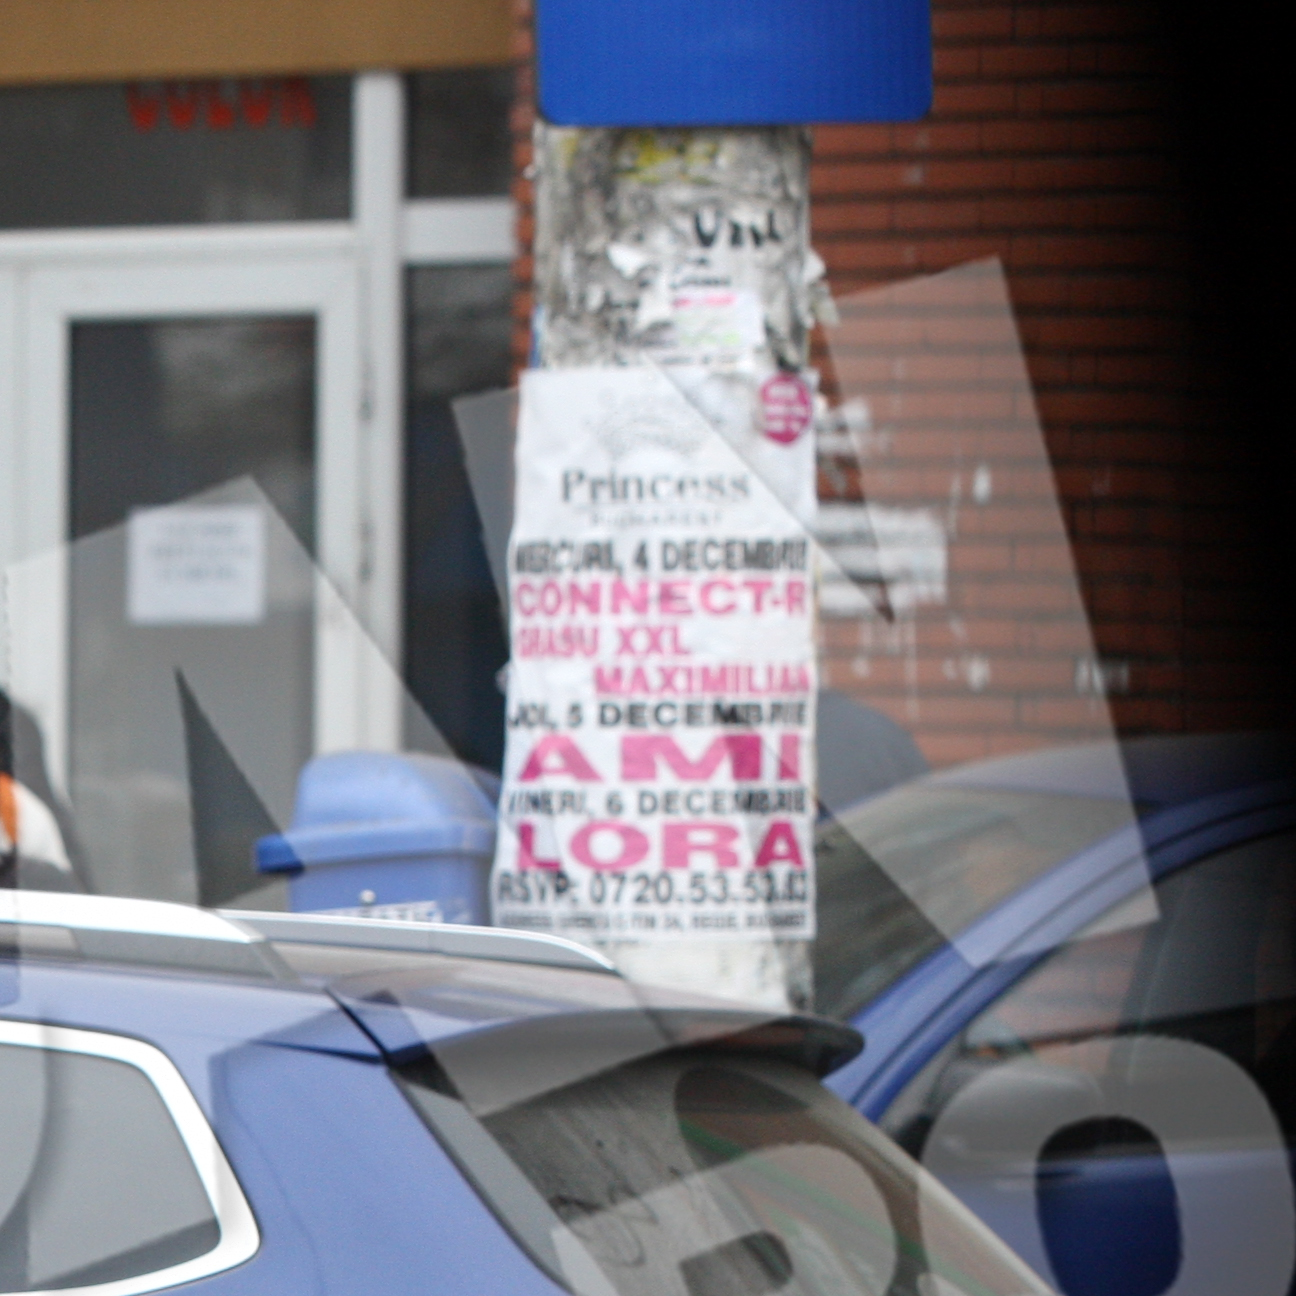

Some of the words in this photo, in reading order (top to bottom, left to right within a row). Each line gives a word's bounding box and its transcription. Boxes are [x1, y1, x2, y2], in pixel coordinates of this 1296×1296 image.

[562, 469, 751, 502] Princess
[631, 540, 649, 572] 4
[515, 578, 807, 617] CONNECT-R
[616, 625, 693, 657] XXL
[566, 702, 585, 728] 5
[598, 701, 807, 728] DECEMBRIE
[517, 733, 802, 783] AMI
[605, 790, 624, 816] 6
[516, 818, 805, 873] LORA
